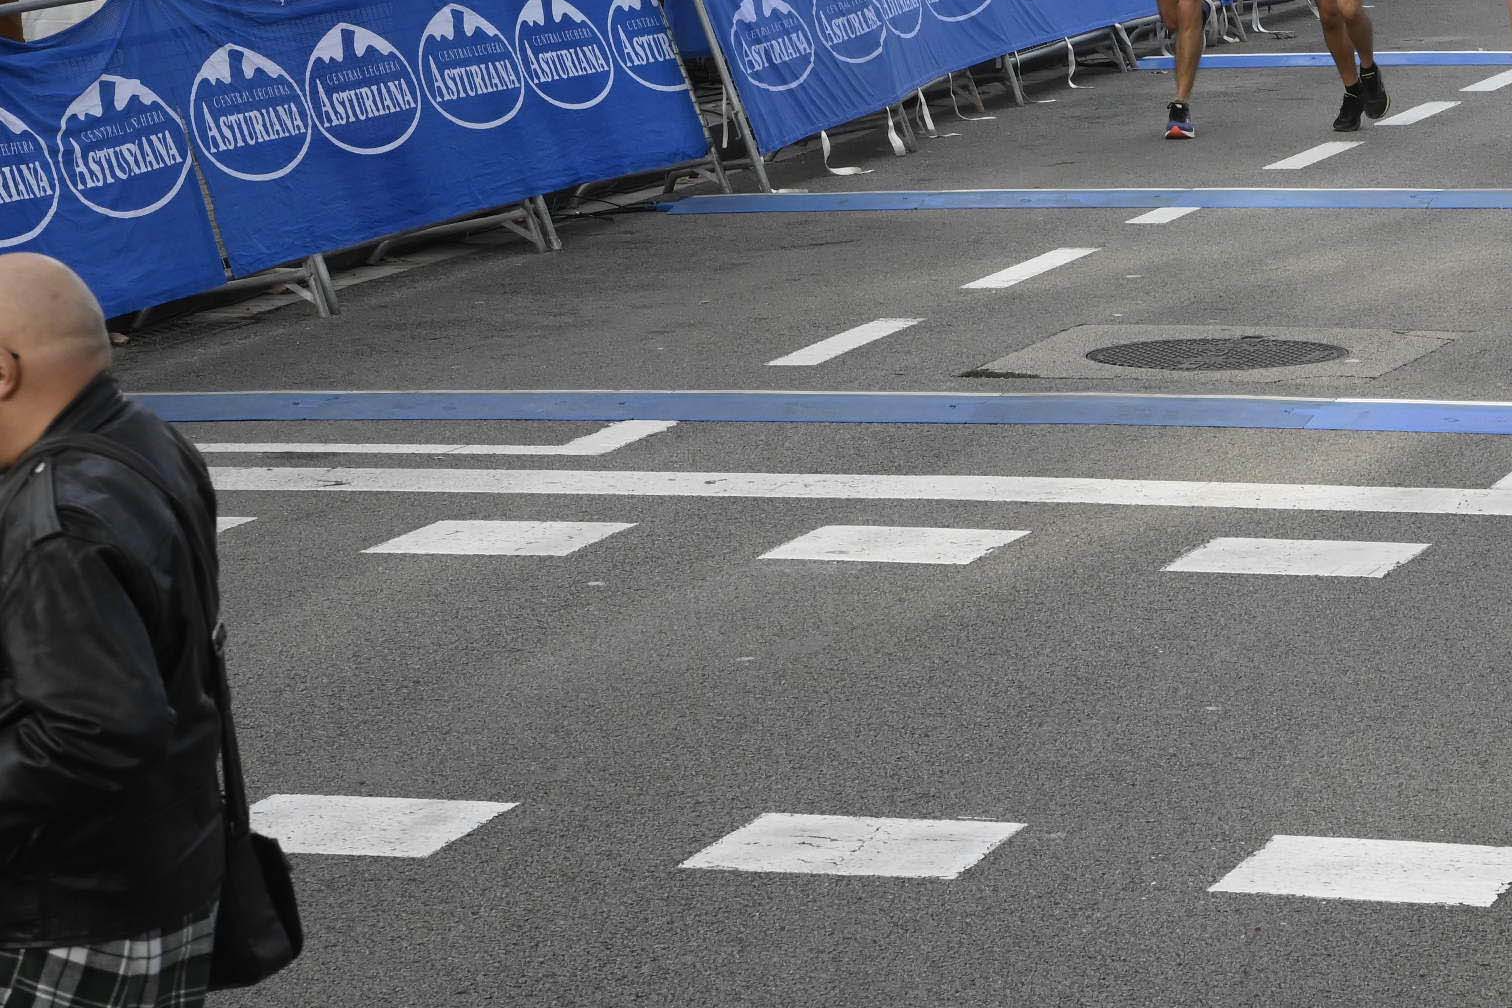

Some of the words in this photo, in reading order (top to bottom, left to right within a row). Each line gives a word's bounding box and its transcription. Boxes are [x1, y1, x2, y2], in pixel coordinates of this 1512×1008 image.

[326, 69, 363, 86] CENTRAL
[363, 60, 401, 78] LECHERA
[429, 54, 521, 103] ASTURIANA
[524, 39, 610, 85] ASTURIANA
[213, 92, 252, 110] CENTRAL
[316, 77, 417, 129] ASTURIANA
[81, 125, 123, 143] CENTRAL
[202, 101, 306, 154] ASTURIANA
